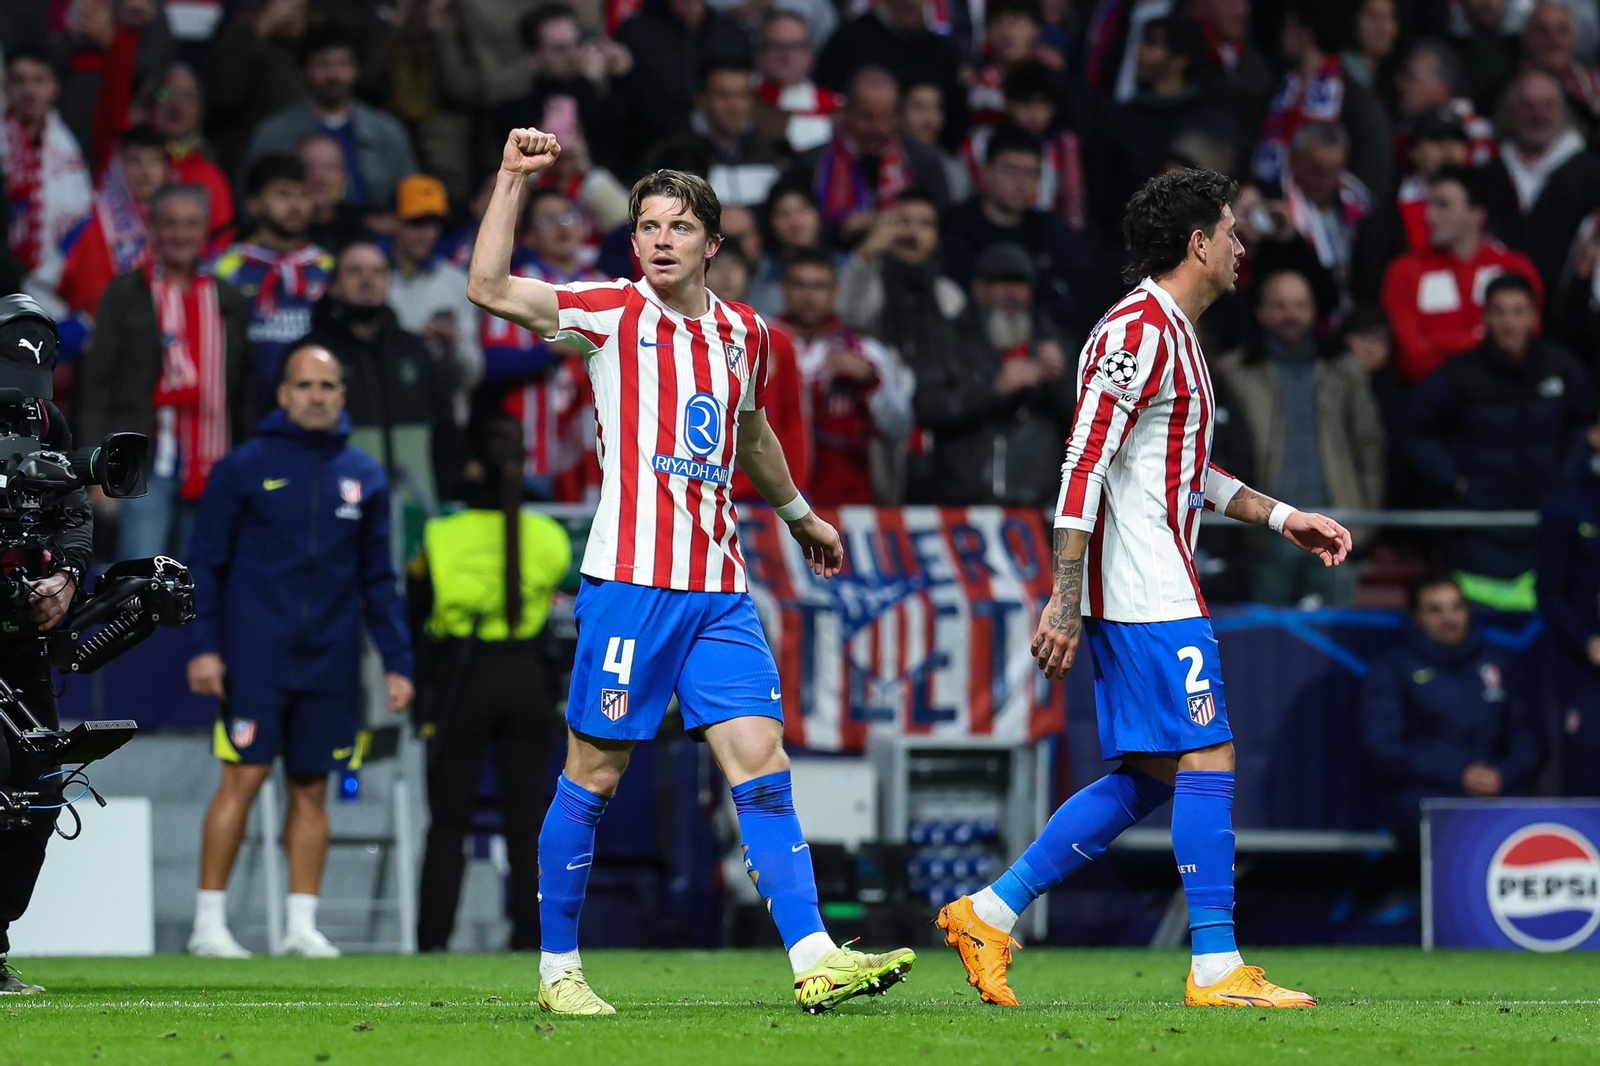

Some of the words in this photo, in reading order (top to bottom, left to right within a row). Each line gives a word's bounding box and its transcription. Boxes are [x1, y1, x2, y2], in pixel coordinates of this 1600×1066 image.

[655, 456, 710, 479] RIYADH
[711, 468, 728, 483] AIR
[602, 636, 635, 685] 4
[1177, 645, 1210, 694] 2
[1499, 876, 1597, 899] PEPSI
